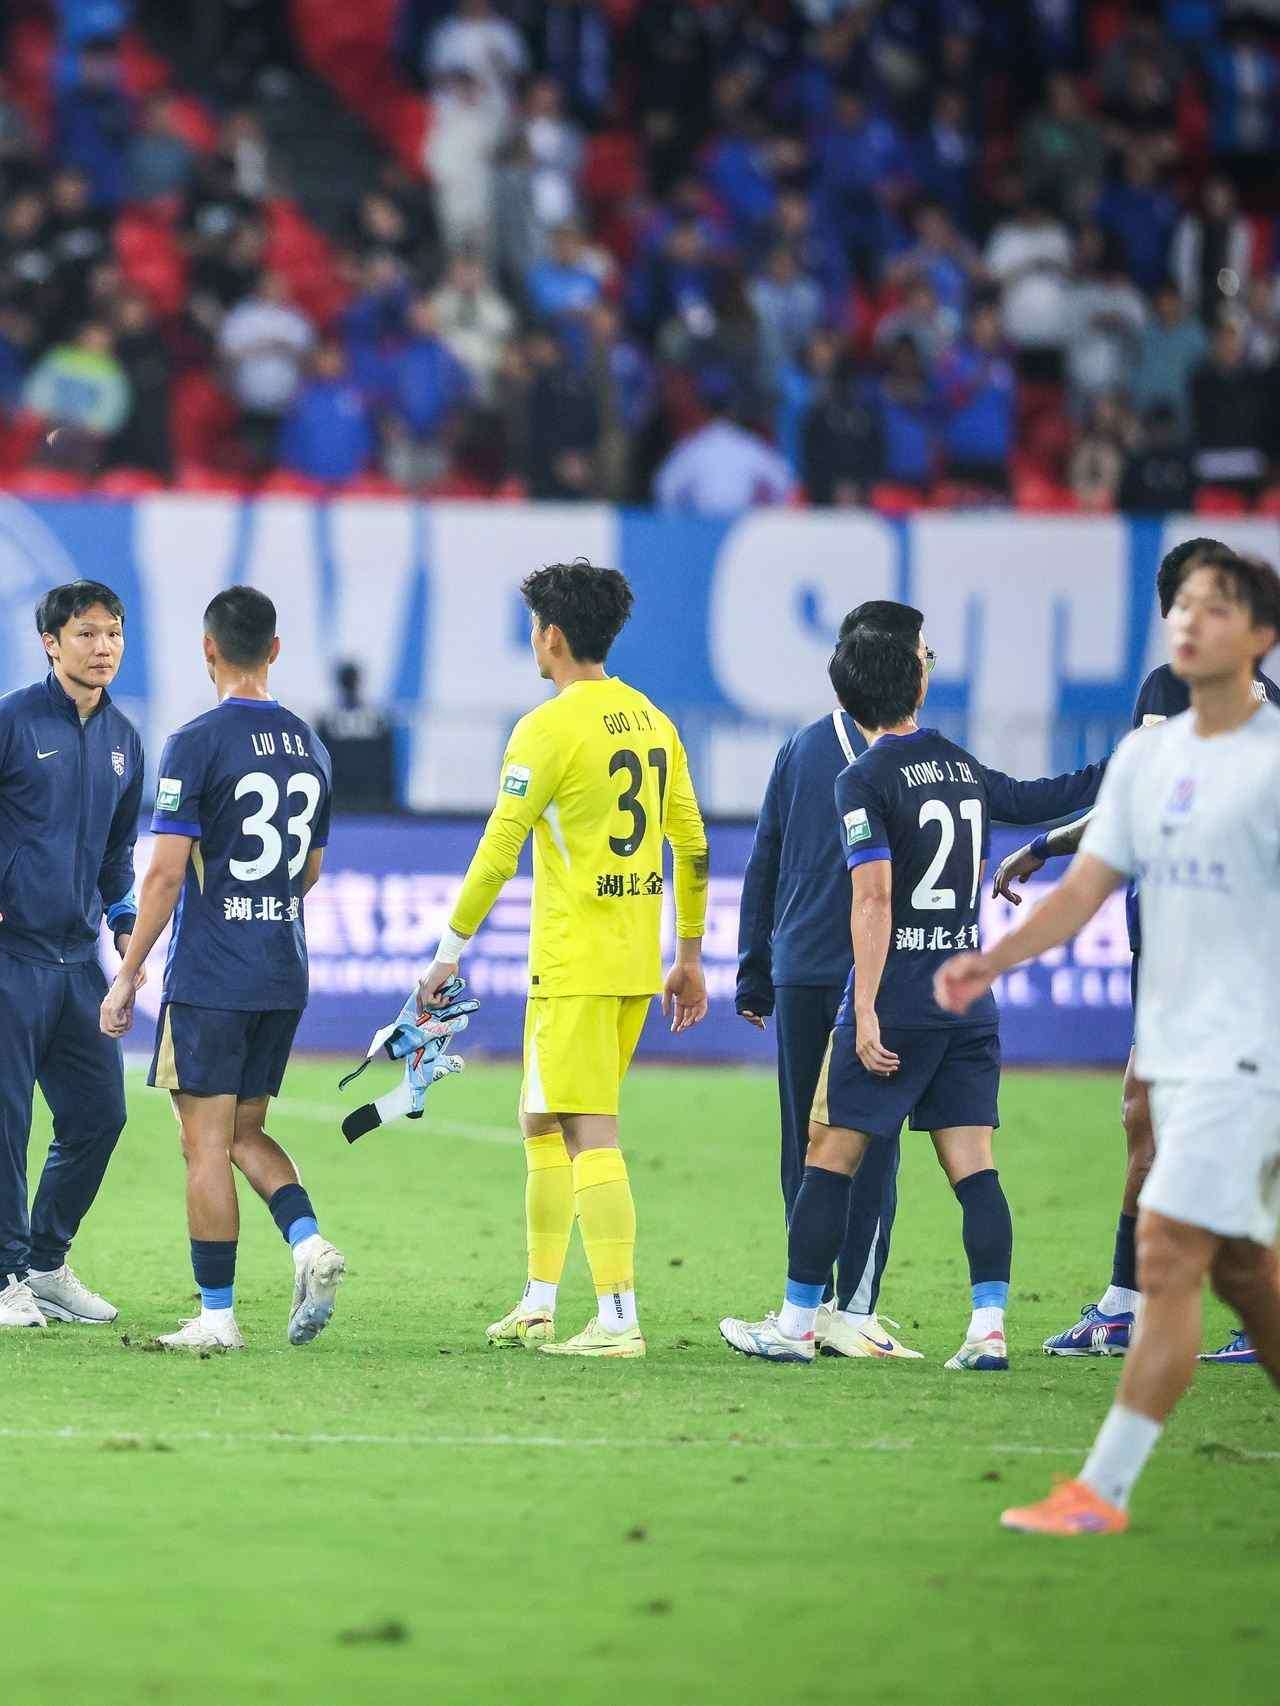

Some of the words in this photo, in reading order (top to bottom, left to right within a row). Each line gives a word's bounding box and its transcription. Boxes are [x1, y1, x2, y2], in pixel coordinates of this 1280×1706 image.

[251, 732, 275, 756] LIU
[281, 731, 309, 757] B.B.
[603, 711, 630, 735] GUO
[608, 747, 668, 858] 31
[900, 760, 944, 788] XIONG
[228, 771, 321, 882] 33
[911, 798, 983, 910] 21
